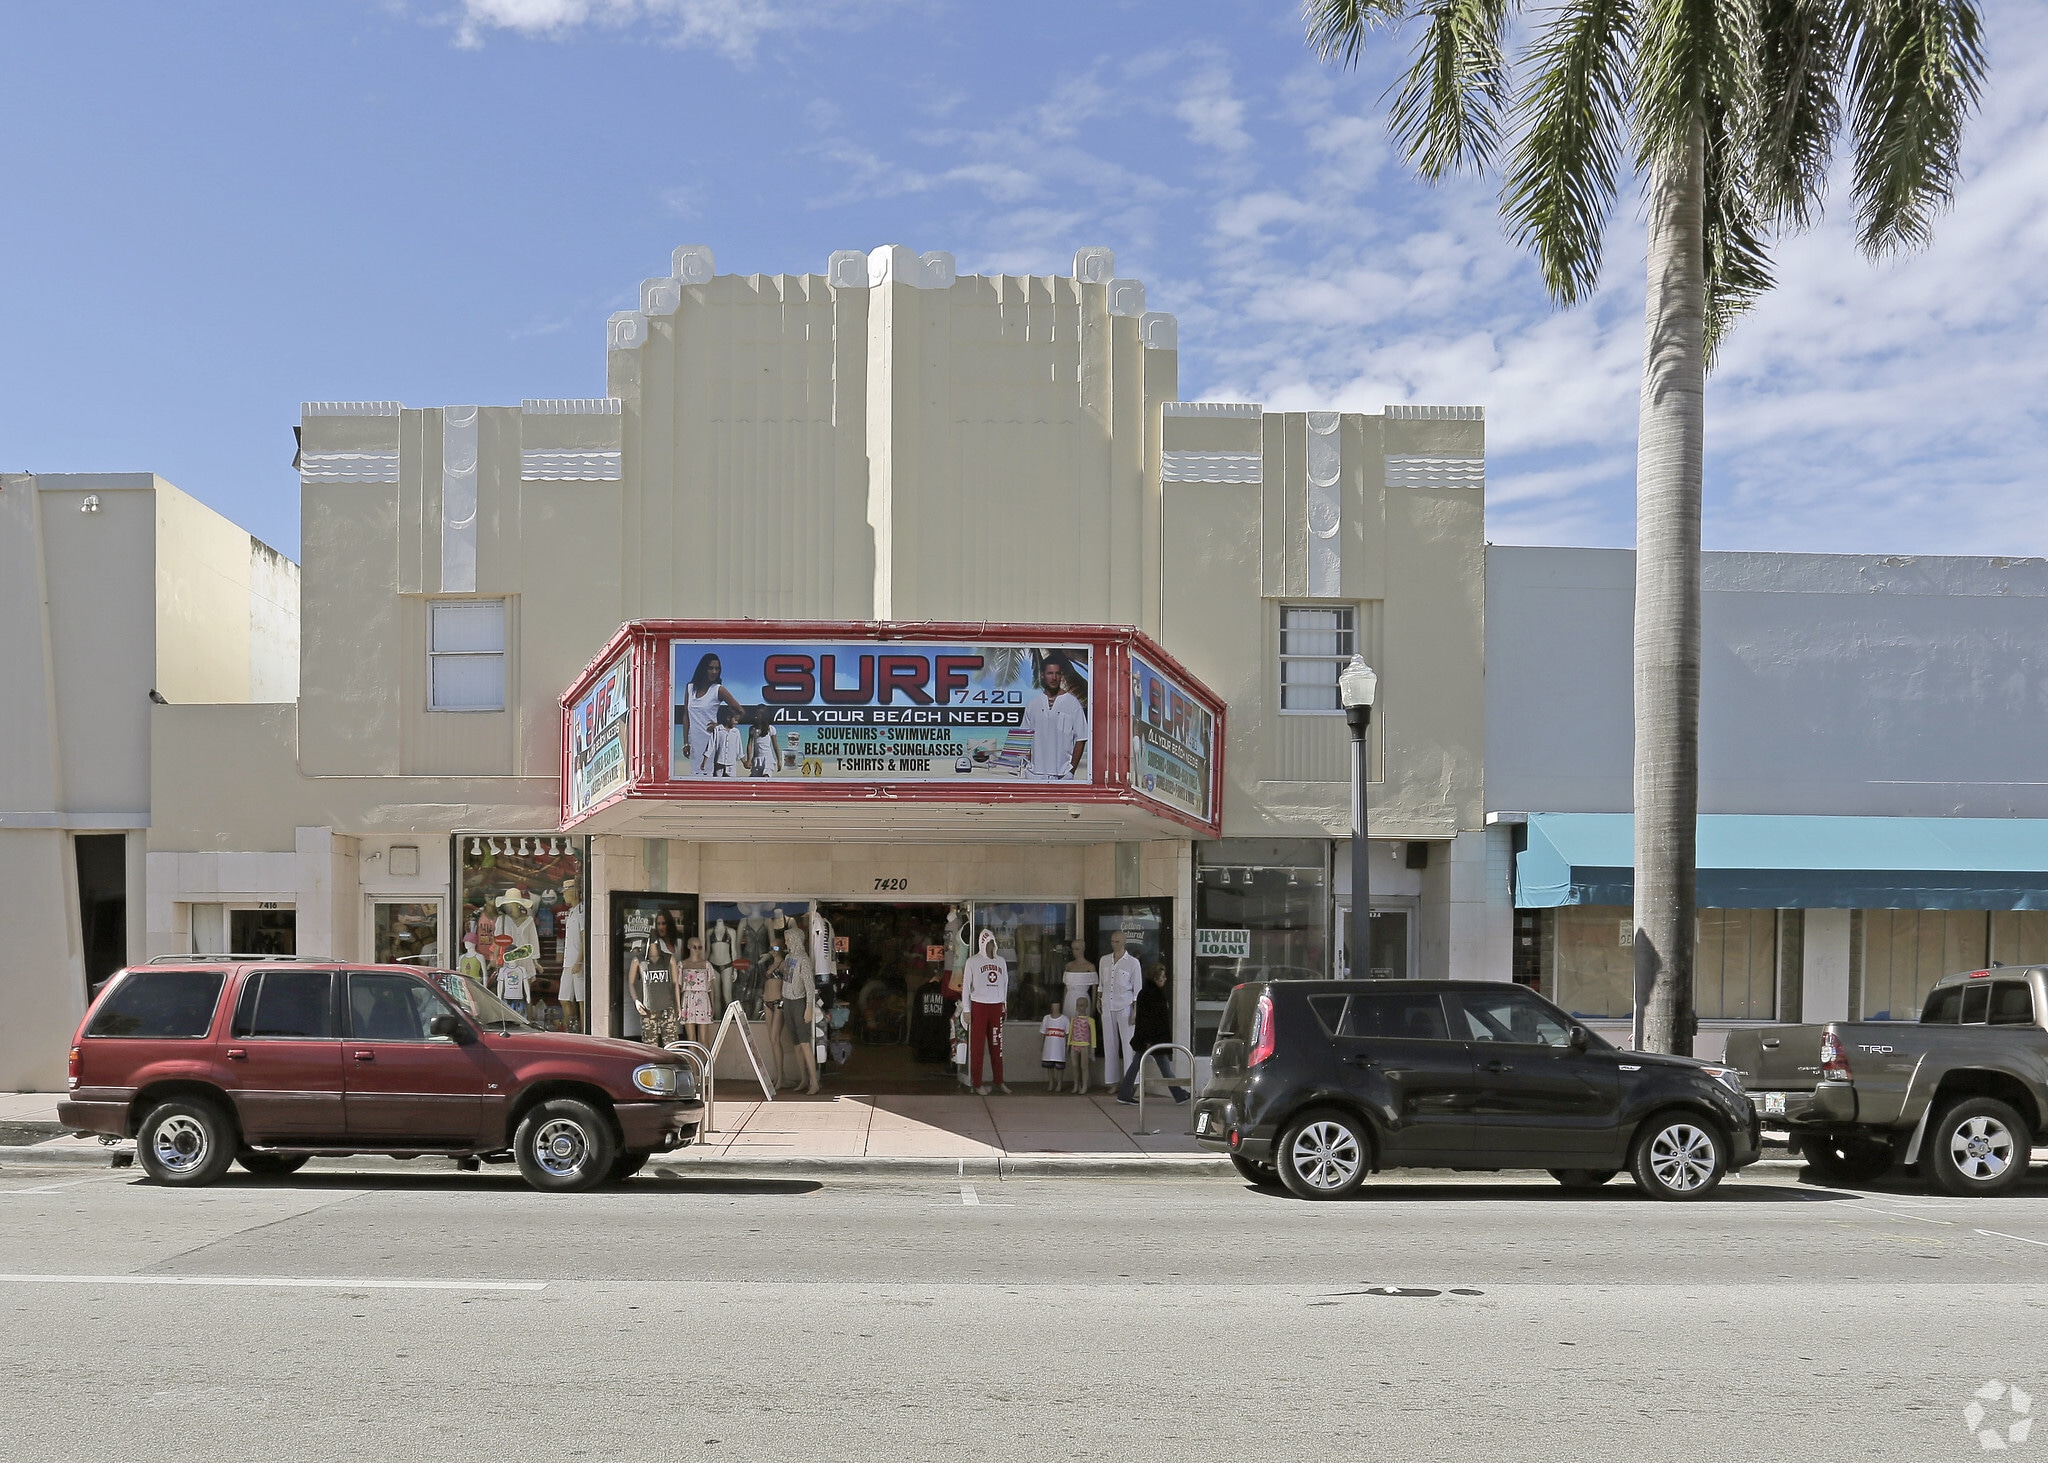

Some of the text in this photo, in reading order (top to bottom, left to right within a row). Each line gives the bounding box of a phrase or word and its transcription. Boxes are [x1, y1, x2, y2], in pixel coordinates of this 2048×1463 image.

[762, 654, 984, 705] SURF
[955, 690, 1022, 704] 7420
[774, 708, 1019, 723] ALL YOUR BEACH NEEDS
[818, 727, 951, 740] SOUVENIRS SWIMWEAR
[804, 742, 963, 756] BEACH TOWELS SUNGLASSES
[836, 758, 930, 772] T-SHIRTS & MORE
[874, 878, 908, 890] 7420
[1198, 930, 1248, 943] JEWELRY
[1202, 944, 1245, 954] LOANS
[1858, 1044, 1894, 1054] TRD
